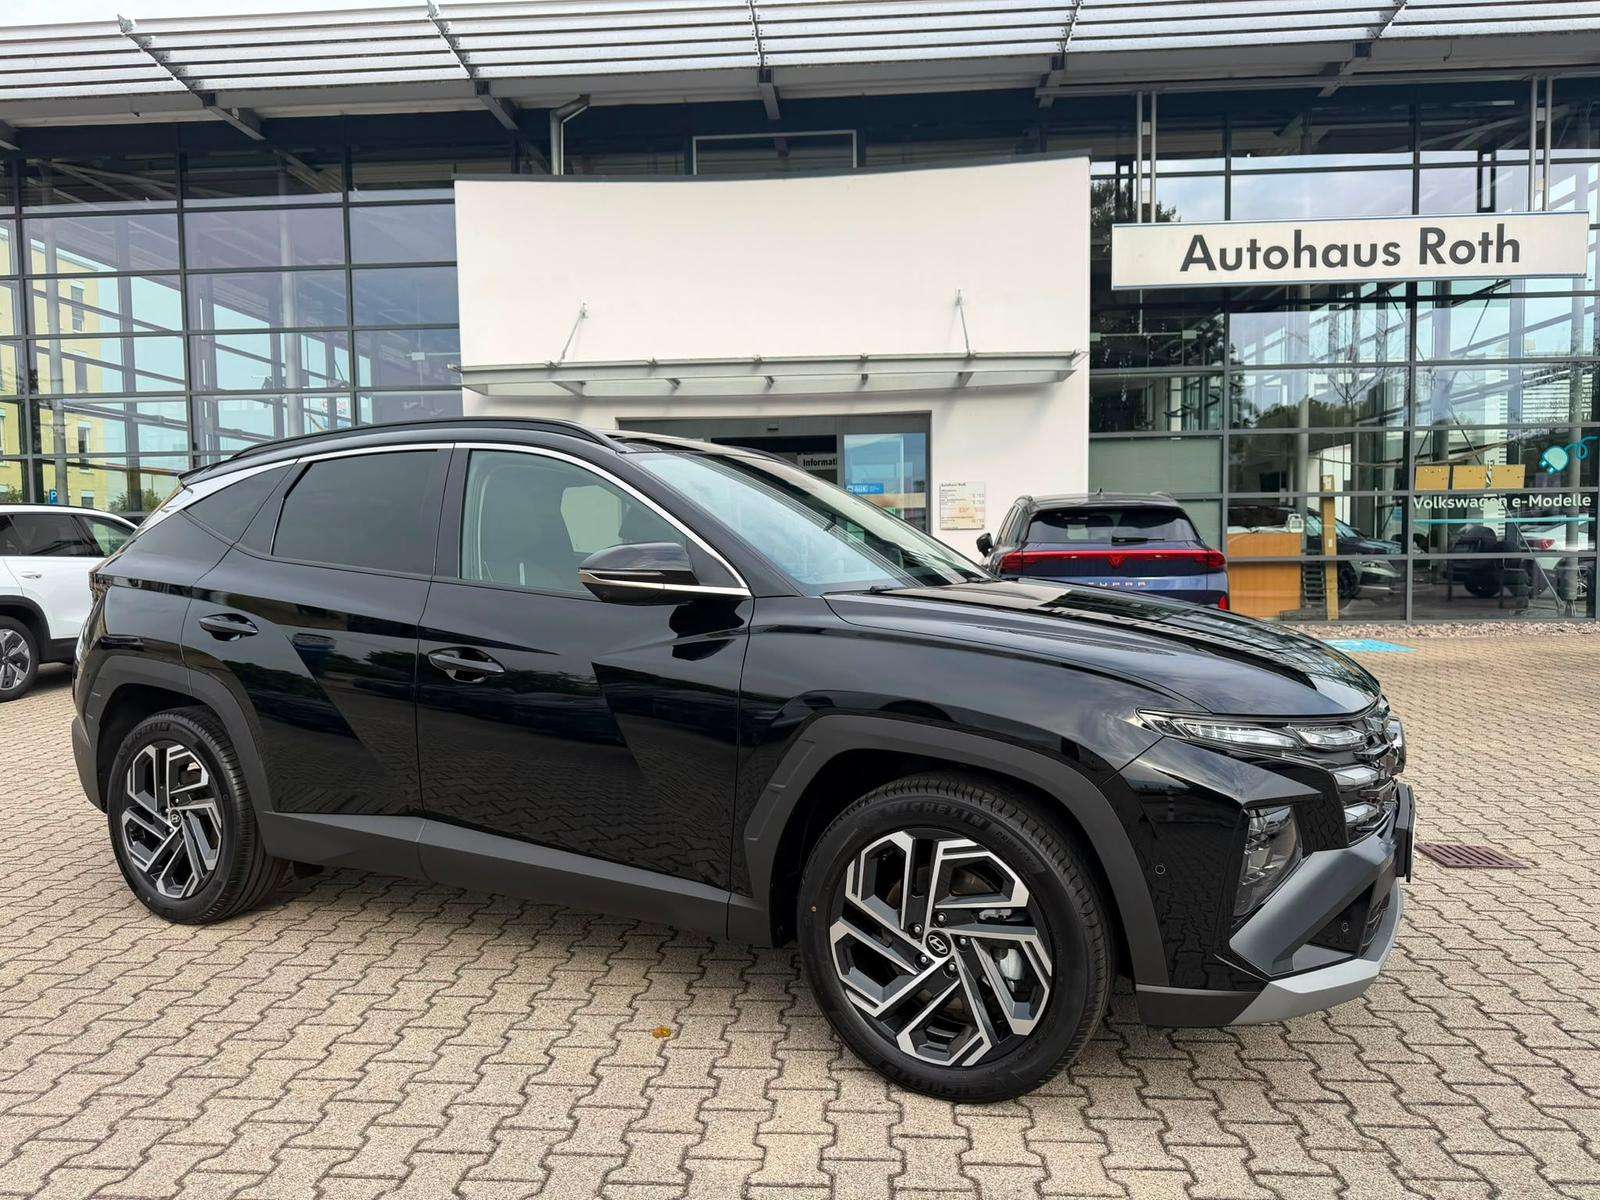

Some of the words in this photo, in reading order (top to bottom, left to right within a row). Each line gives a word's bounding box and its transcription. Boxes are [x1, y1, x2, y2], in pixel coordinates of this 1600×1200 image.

[1179, 229, 1401, 272] Autohaus
[1419, 223, 1520, 265] Roth
[50, 490, 58, 501] P
[1512, 494, 1592, 508] e-Modelle
